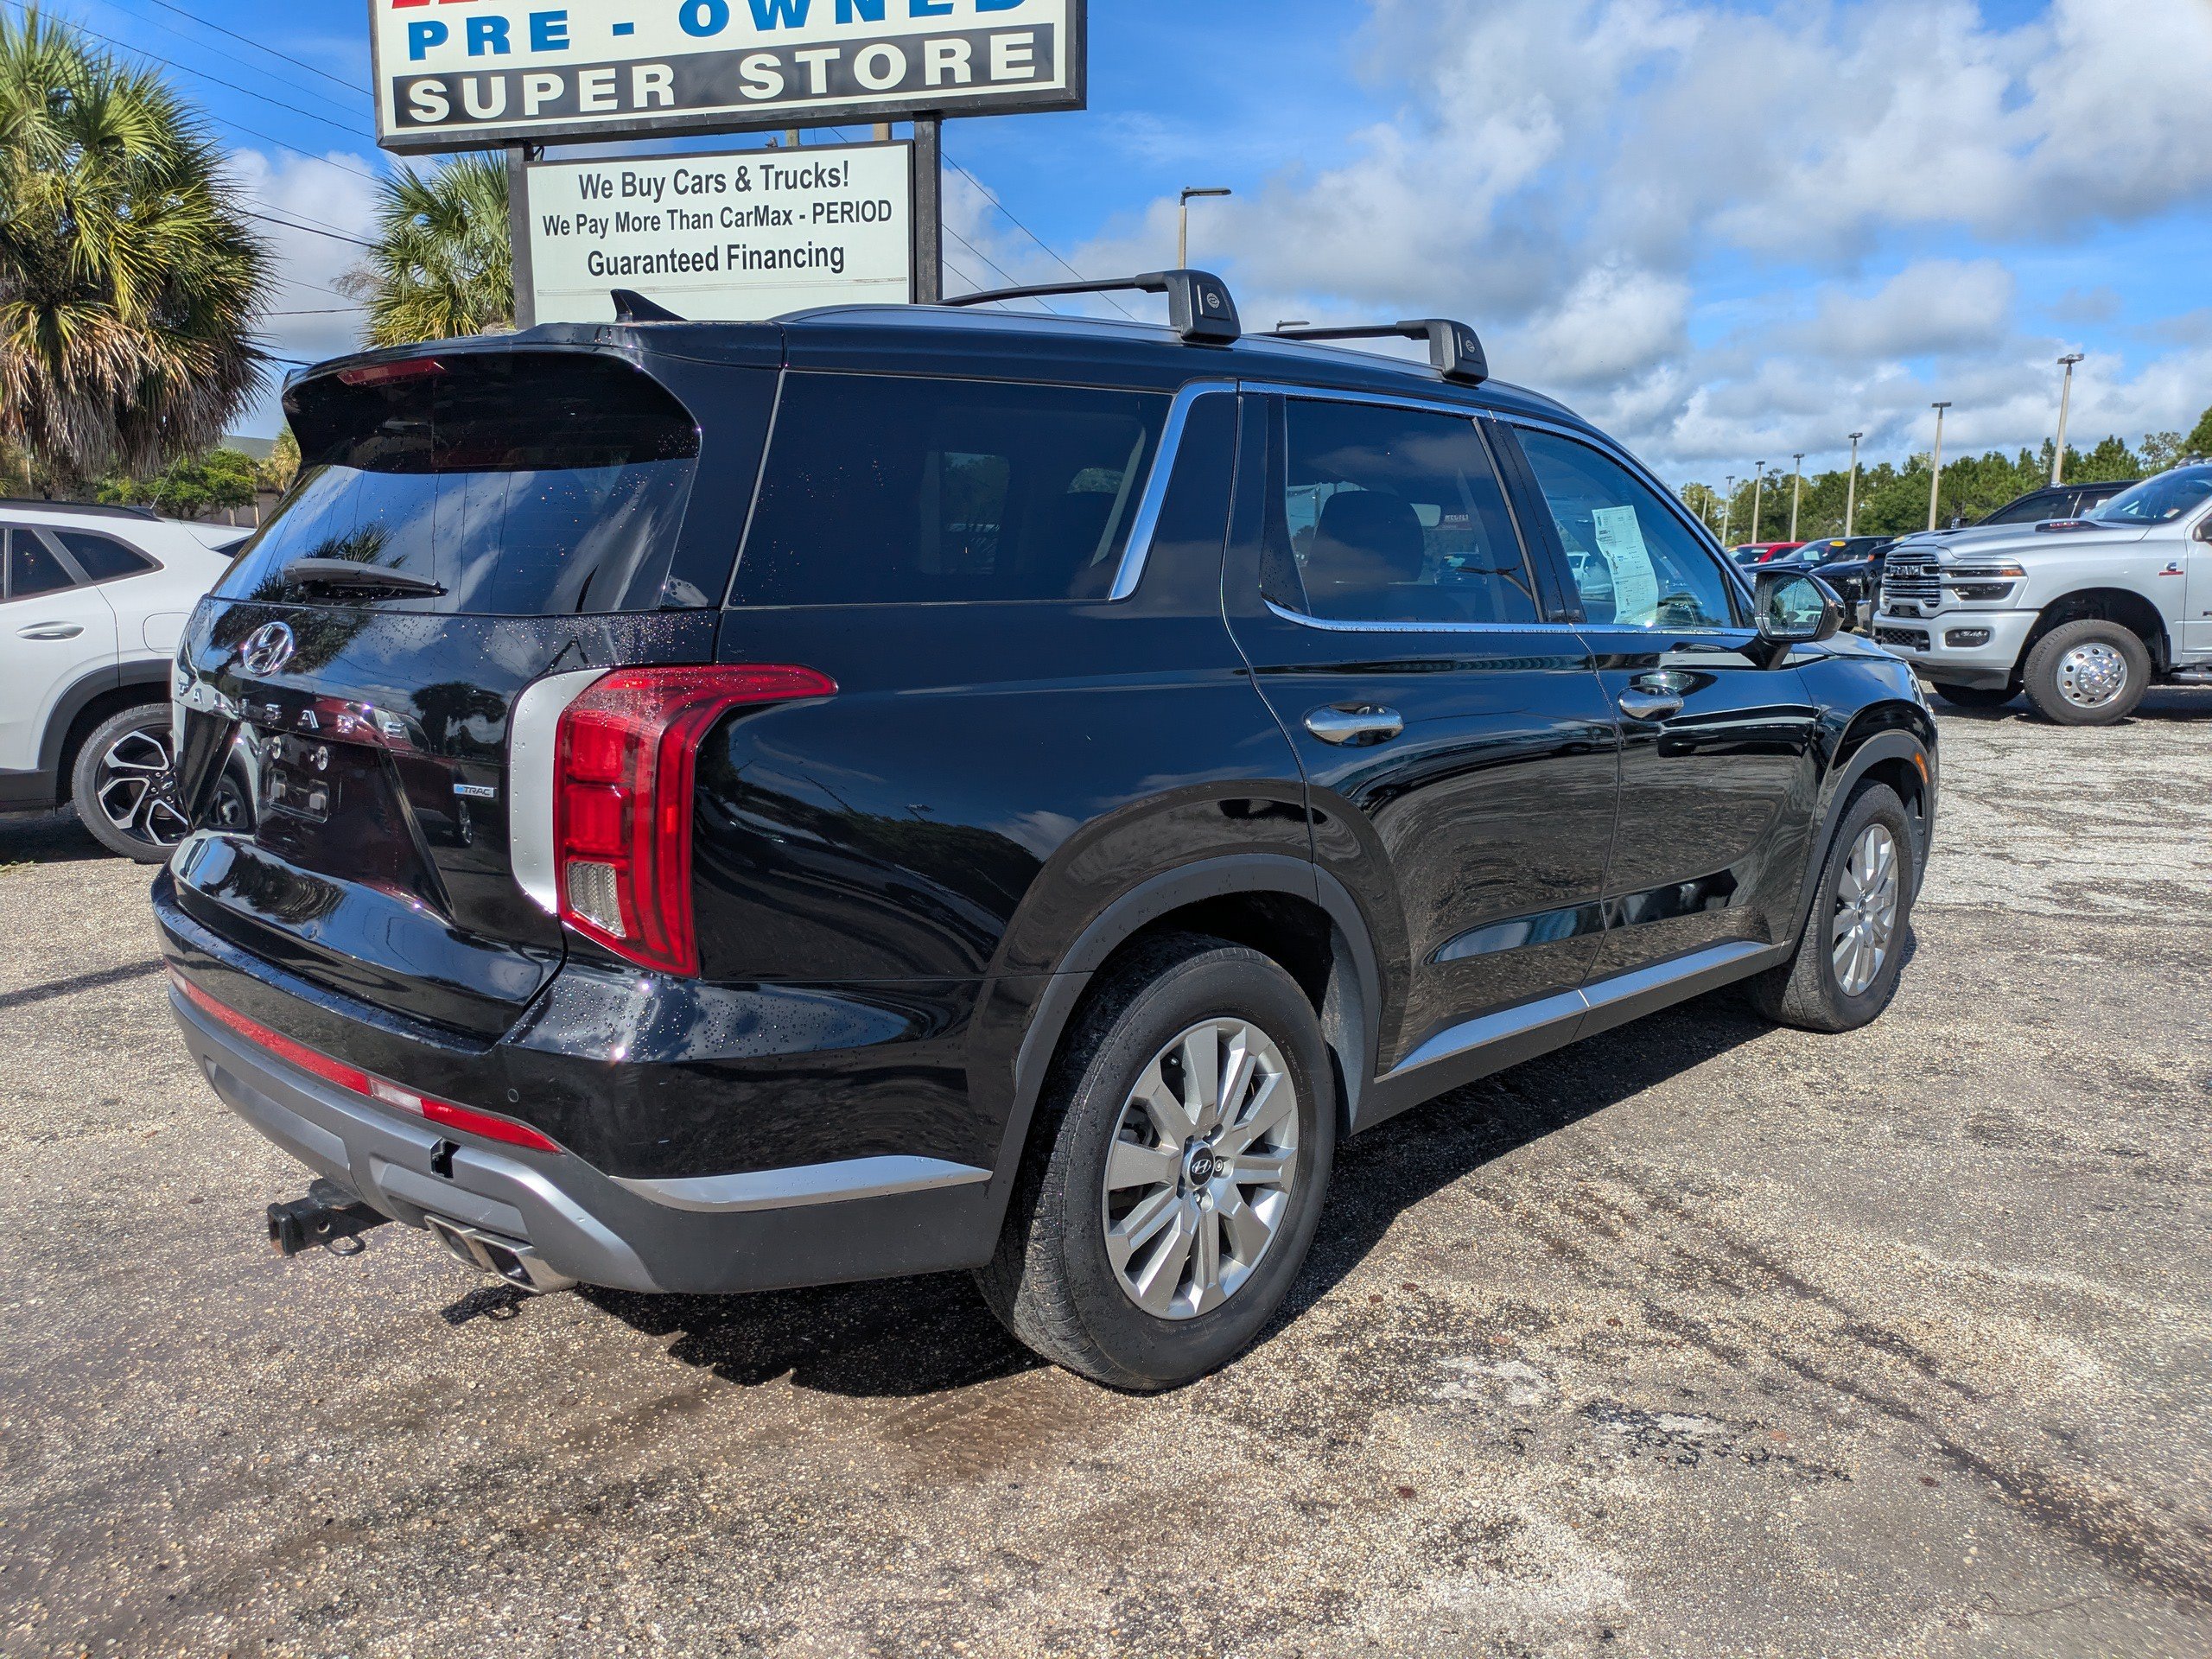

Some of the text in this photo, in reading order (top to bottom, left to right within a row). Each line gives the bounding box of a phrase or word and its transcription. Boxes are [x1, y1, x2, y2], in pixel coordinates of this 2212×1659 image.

[408, 0, 1027, 61] PRE - OWN
[408, 32, 1036, 123] SUPER STORE
[579, 160, 849, 203] We Buy Cars & Trucks!
[543, 214, 570, 237] We
[576, 213, 608, 239] Pay
[615, 210, 661, 233] More
[666, 208, 714, 231] Than
[720, 204, 793, 228] CarMax
[812, 200, 893, 225] PERIOD
[588, 241, 845, 277] Guaranteed Financing
